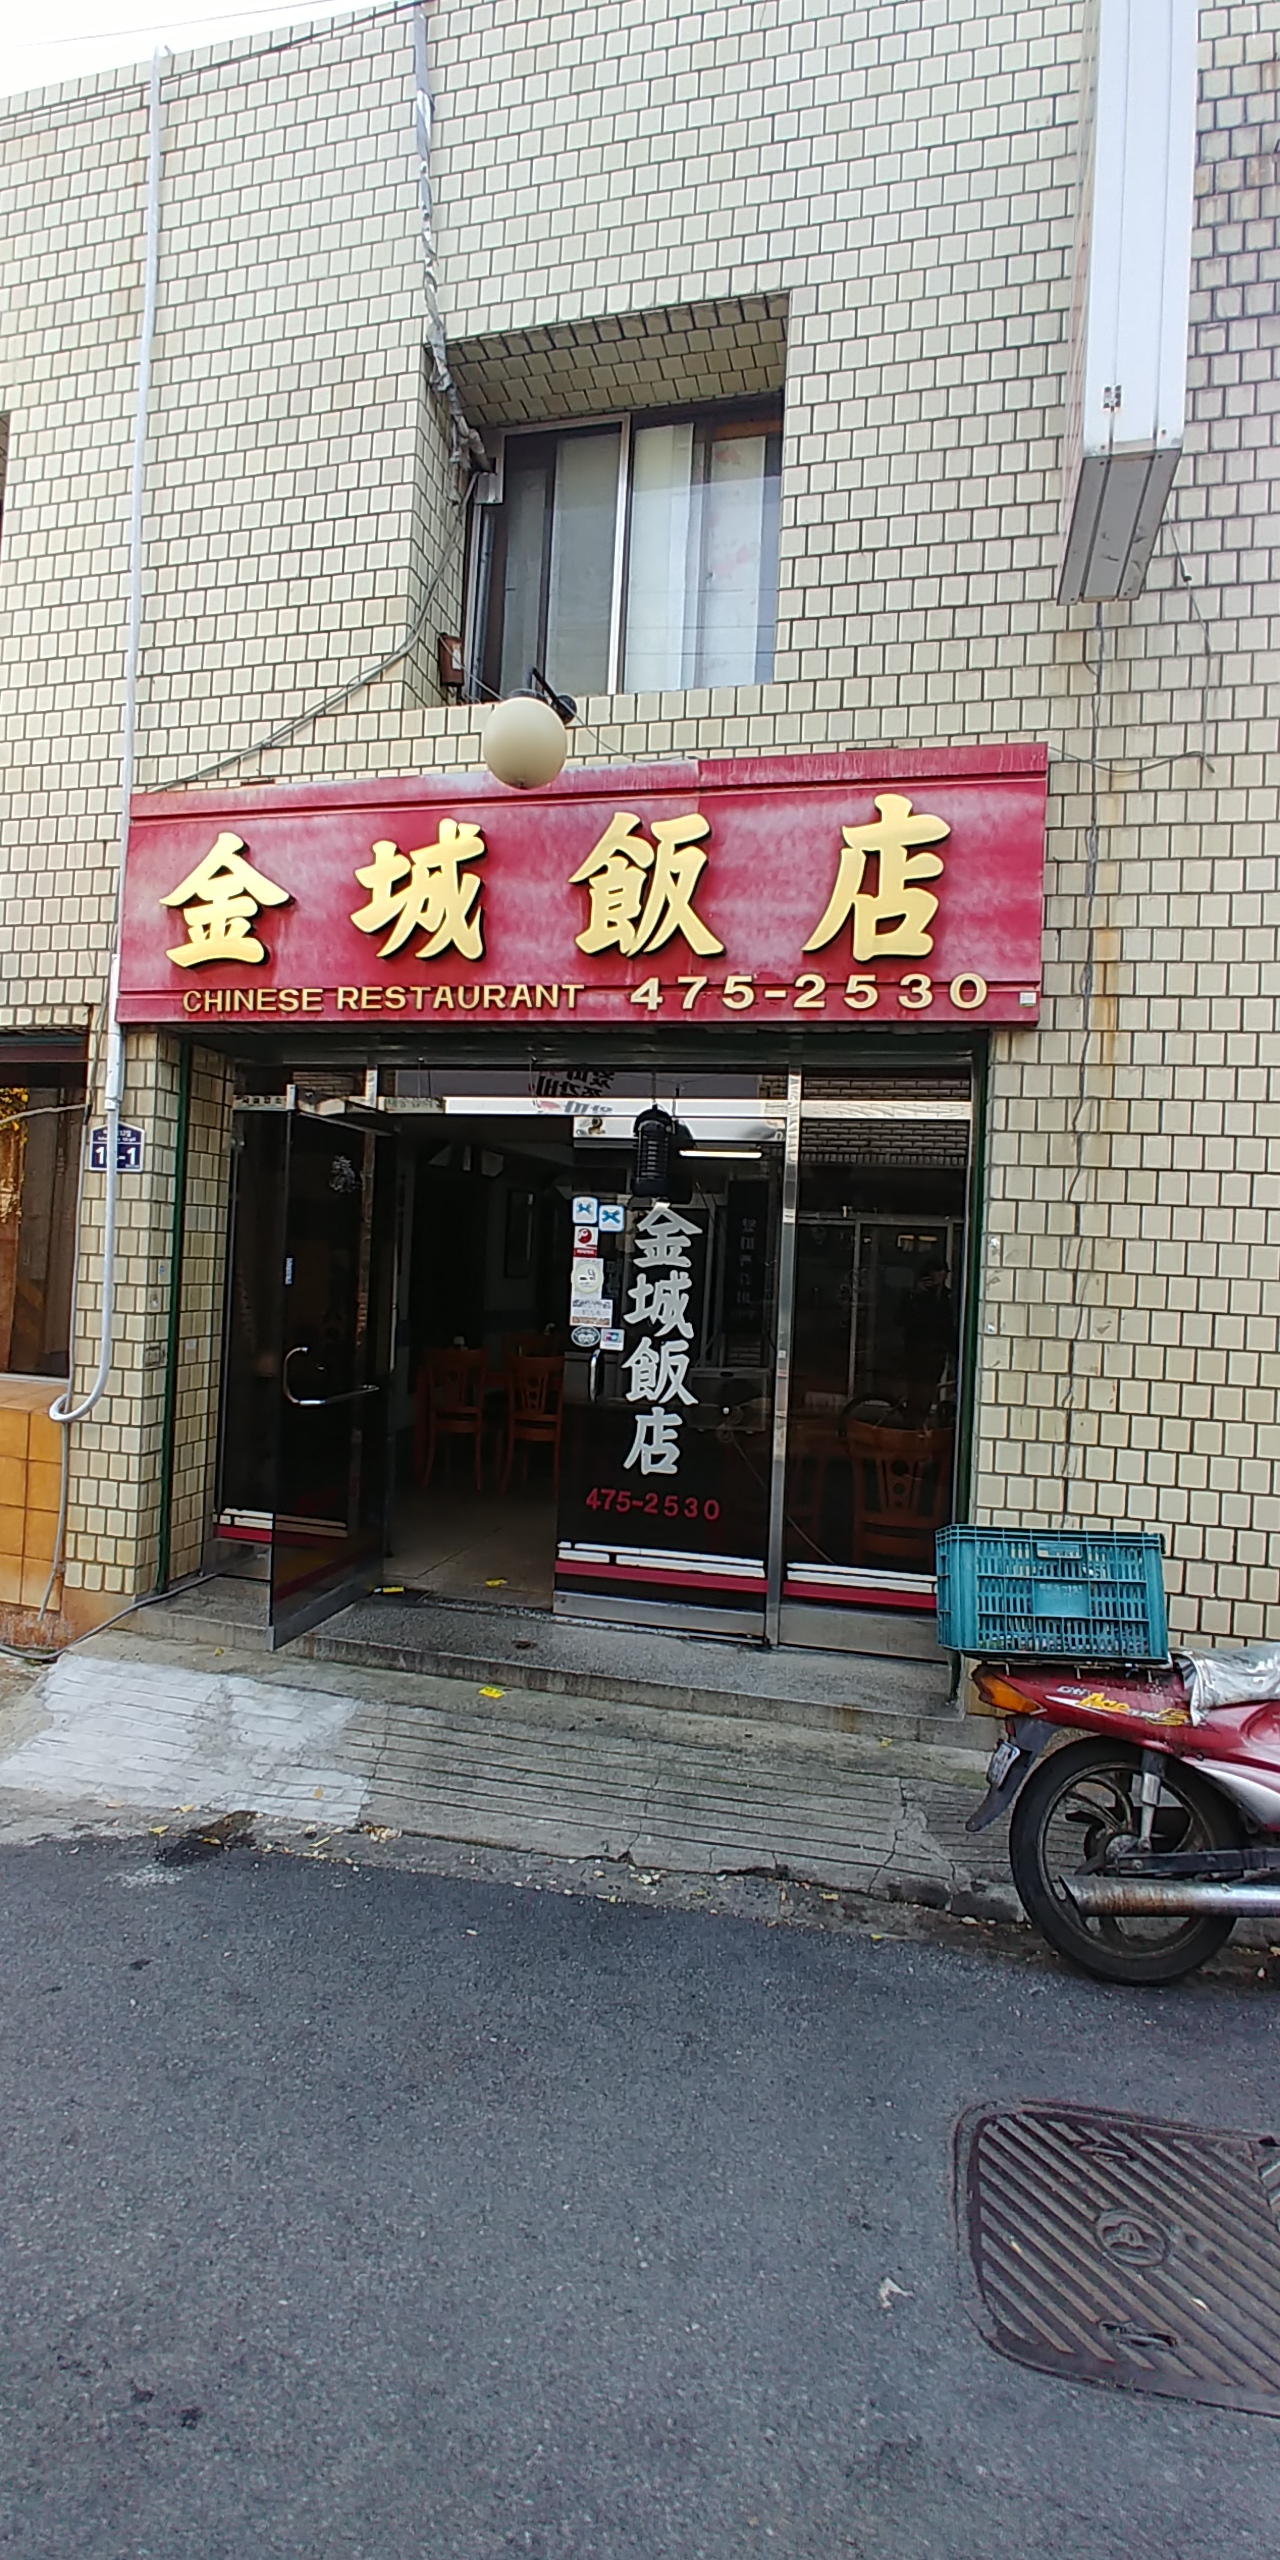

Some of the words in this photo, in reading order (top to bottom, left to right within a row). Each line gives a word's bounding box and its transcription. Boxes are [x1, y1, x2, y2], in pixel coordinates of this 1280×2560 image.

[159, 793, 952, 968] 金城飯店
[182, 987, 323, 1013] CHINESE
[336, 984, 585, 1011] RESTAURANT
[630, 973, 988, 1011] 475-2530
[95, 1146, 136, 1165] 1-1
[620, 1201, 703, 1476] 金城飯店
[586, 1487, 720, 1520] 475-2530
